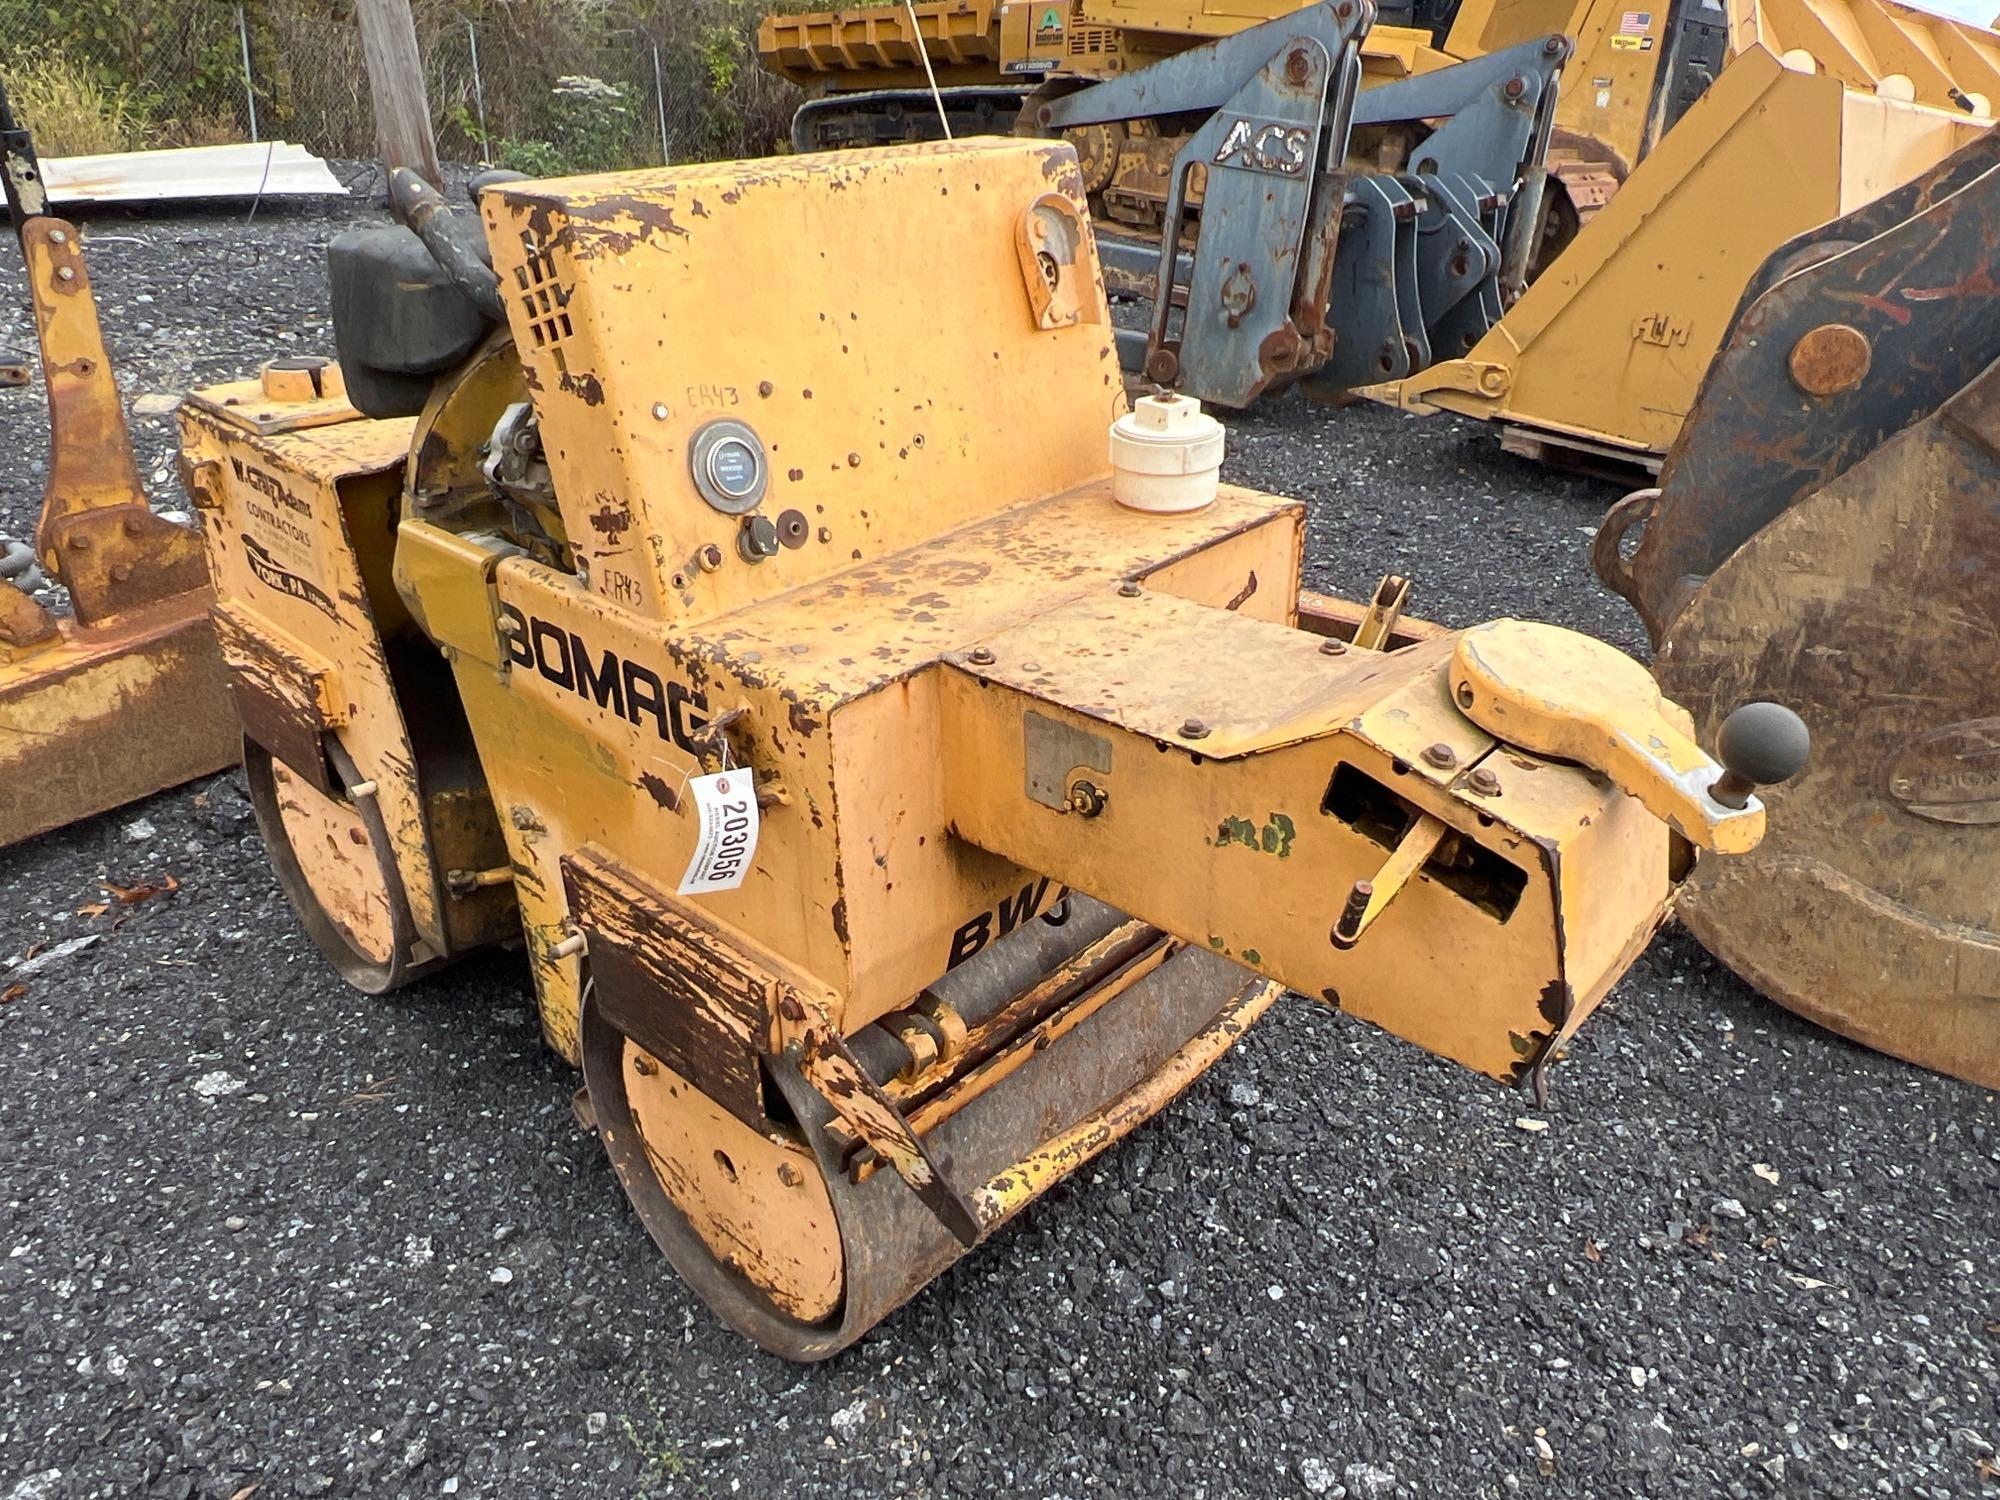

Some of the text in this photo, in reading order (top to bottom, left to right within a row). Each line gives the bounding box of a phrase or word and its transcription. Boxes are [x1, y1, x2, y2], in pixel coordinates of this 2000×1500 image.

[1213, 119, 1311, 174] ACS
[687, 384, 739, 408] ER43
[246, 500, 312, 548] CONTRACTORS
[601, 569, 643, 607] ER43
[501, 600, 710, 755] BOMAG
[708, 800, 750, 881] 203056
